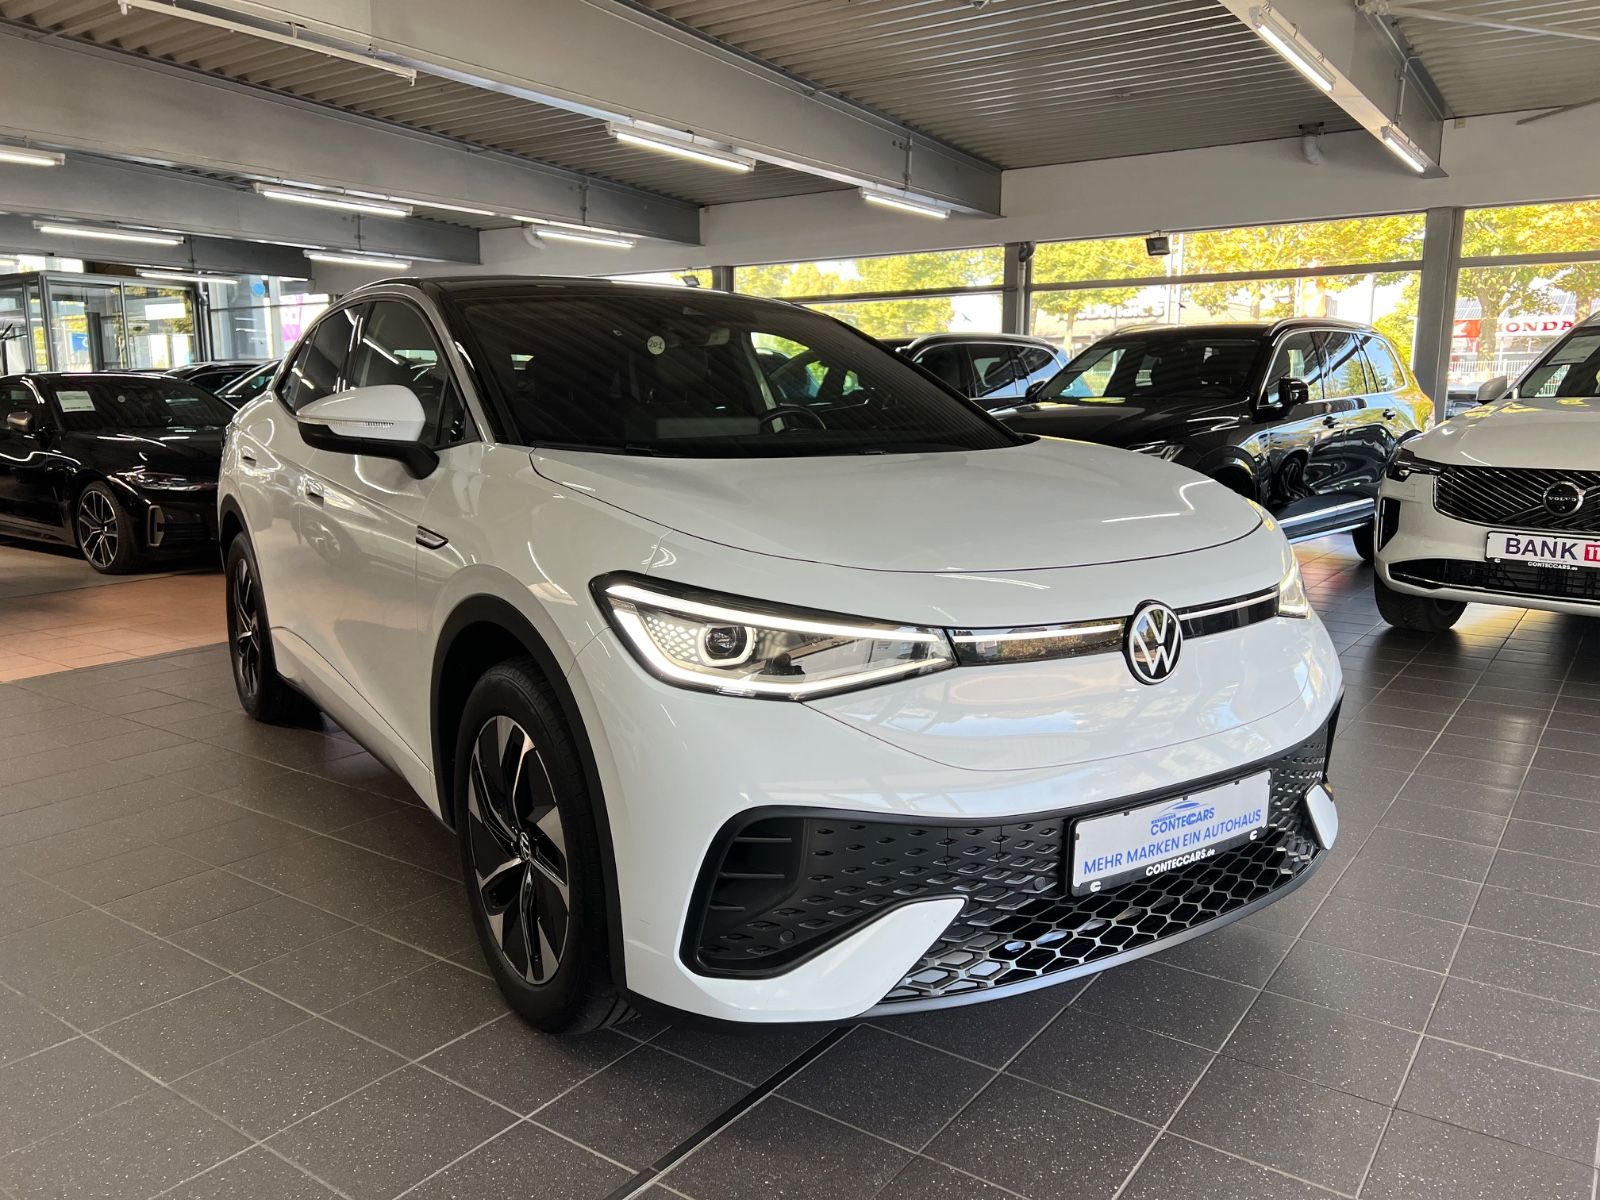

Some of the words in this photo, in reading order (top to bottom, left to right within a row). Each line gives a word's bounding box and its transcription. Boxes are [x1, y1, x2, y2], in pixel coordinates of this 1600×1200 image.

[1505, 537, 1578, 561] BANK
[1150, 807, 1215, 836] CONTECCARS
[1084, 852, 1123, 875] MEHR
[1126, 835, 1180, 863] MARKEN
[1182, 830, 1201, 847] EIN
[1203, 809, 1261, 840] AUTOHAUS
[1145, 848, 1216, 876] CONTECCARS.de
